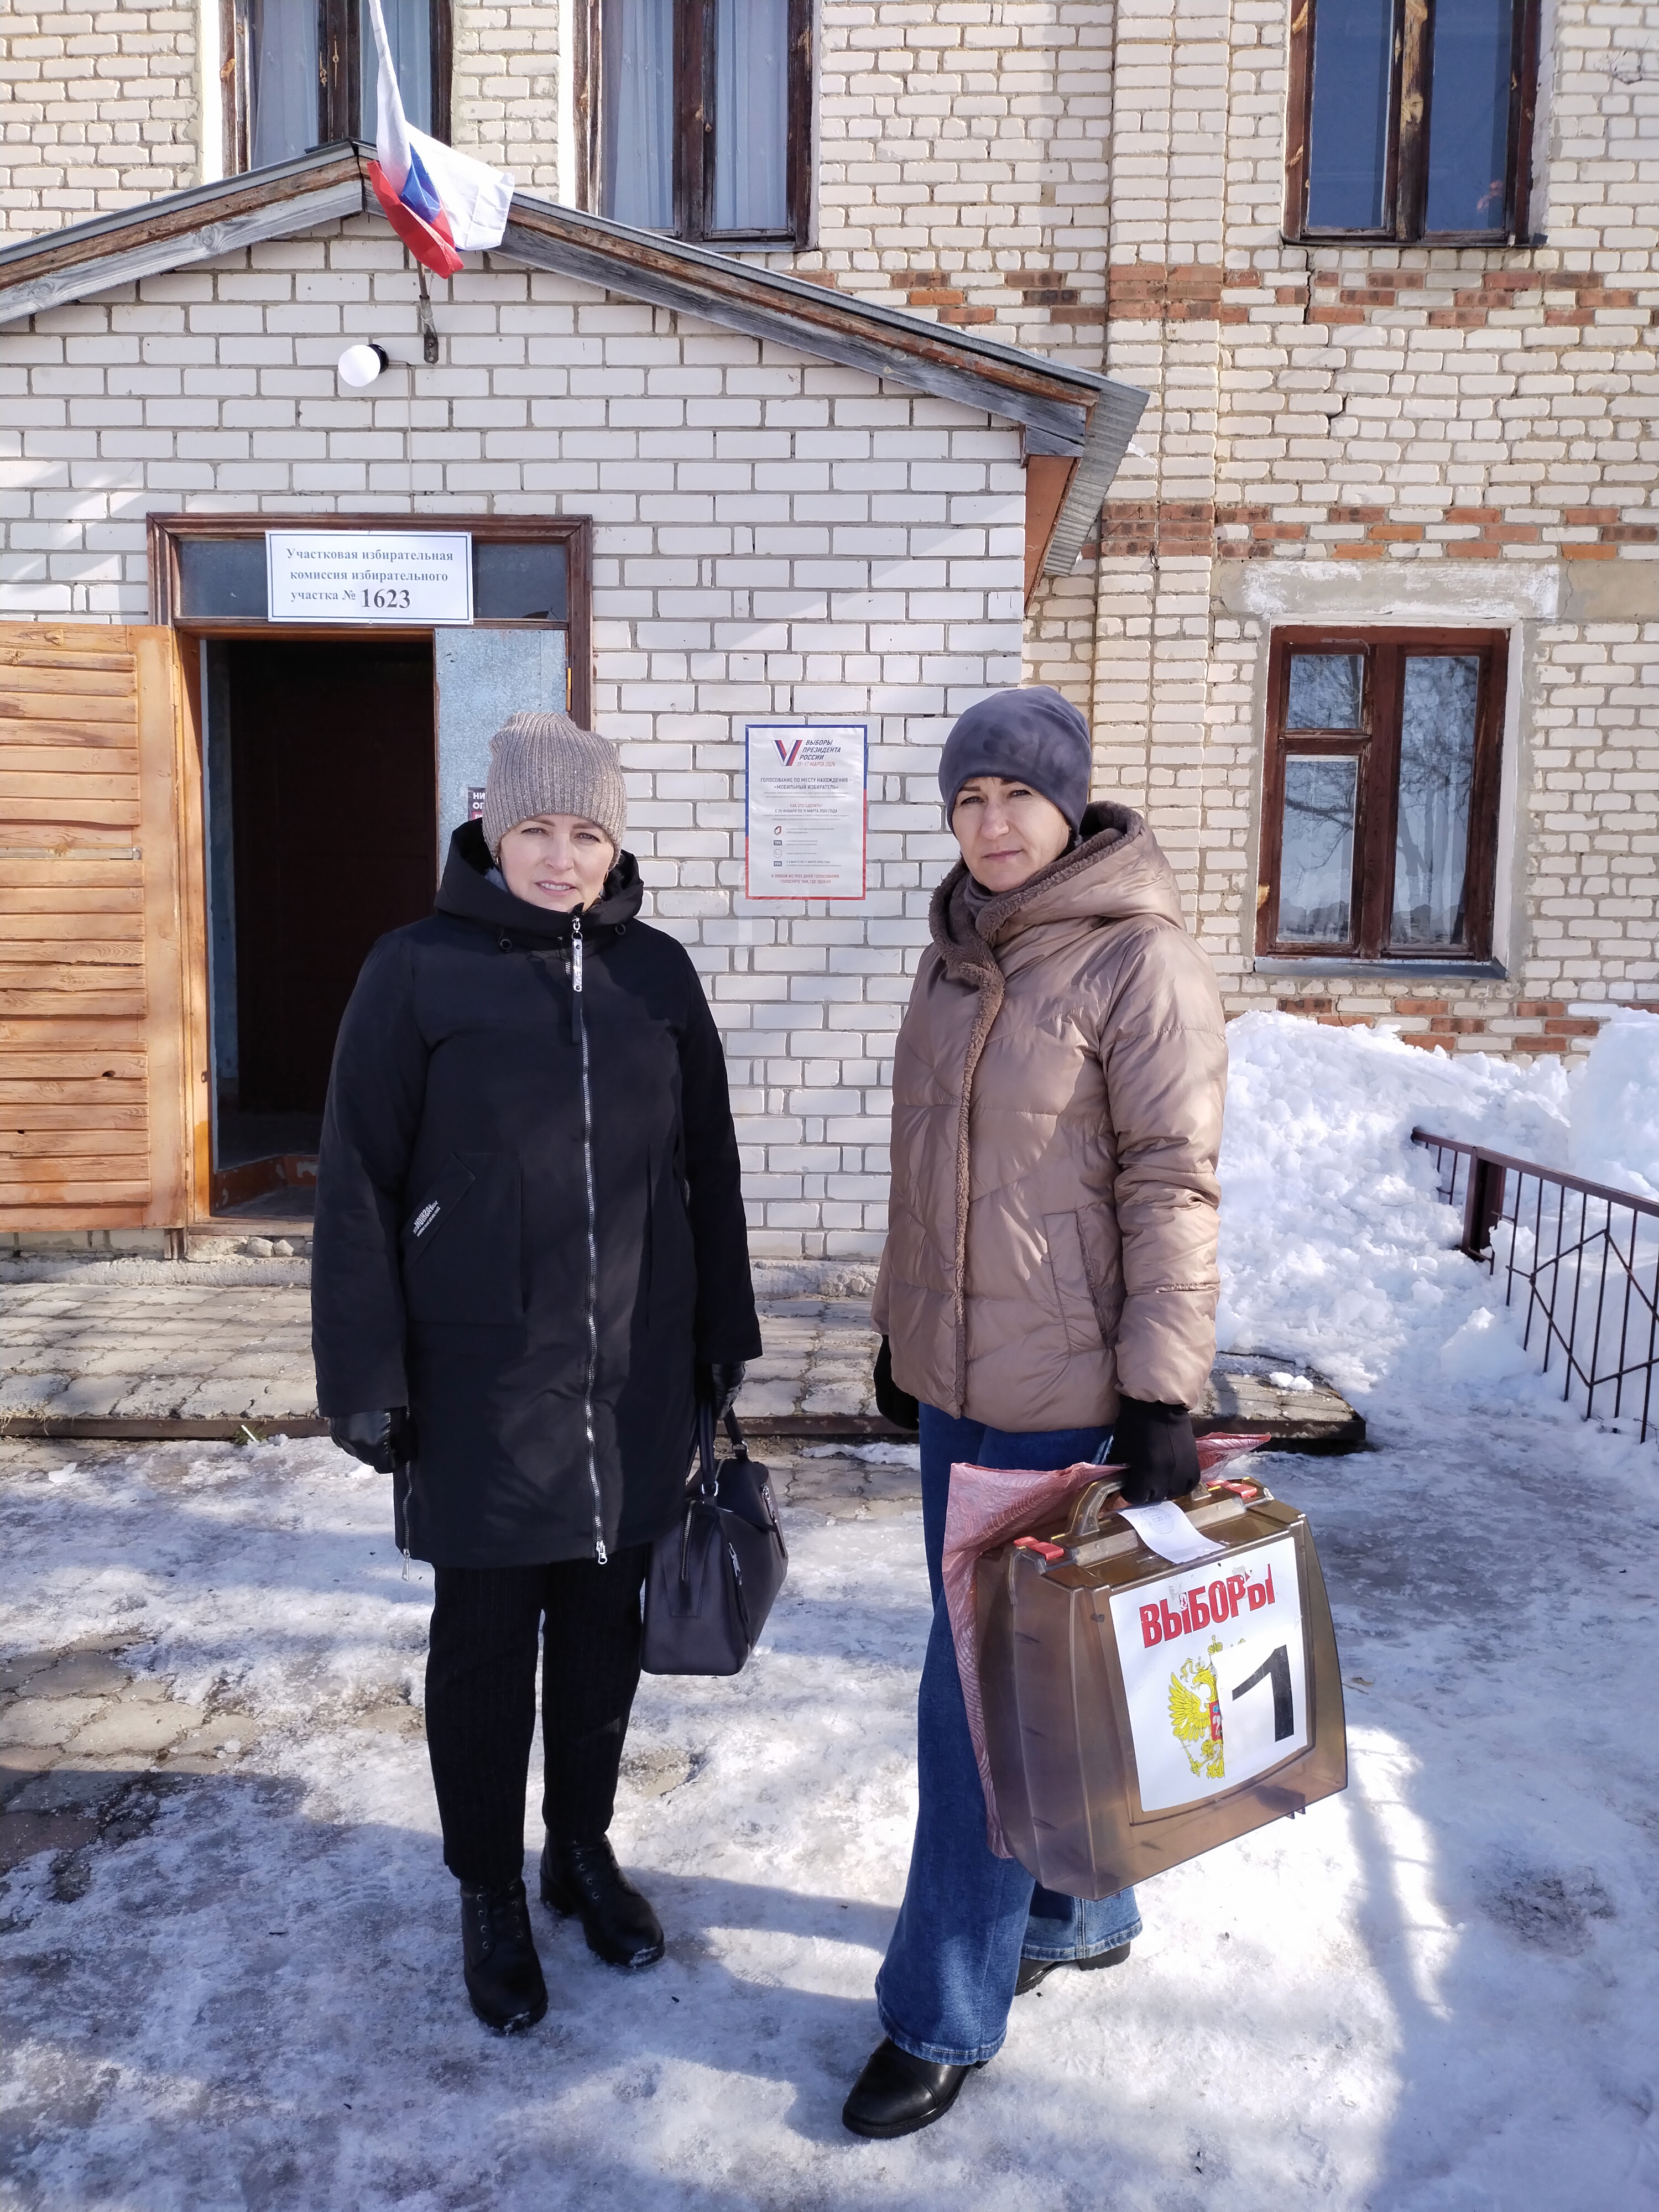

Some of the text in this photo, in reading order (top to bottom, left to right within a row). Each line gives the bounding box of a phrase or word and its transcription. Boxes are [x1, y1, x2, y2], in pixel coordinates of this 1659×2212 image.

[286, 548, 453, 562] Участковая избирательная
[290, 570, 448, 583] комиссия избирательного
[290, 588, 411, 609] участка № 1623
[1139, 1564, 1275, 1648] ВЫБОРЫ
[1232, 1644, 1294, 1743] 1
